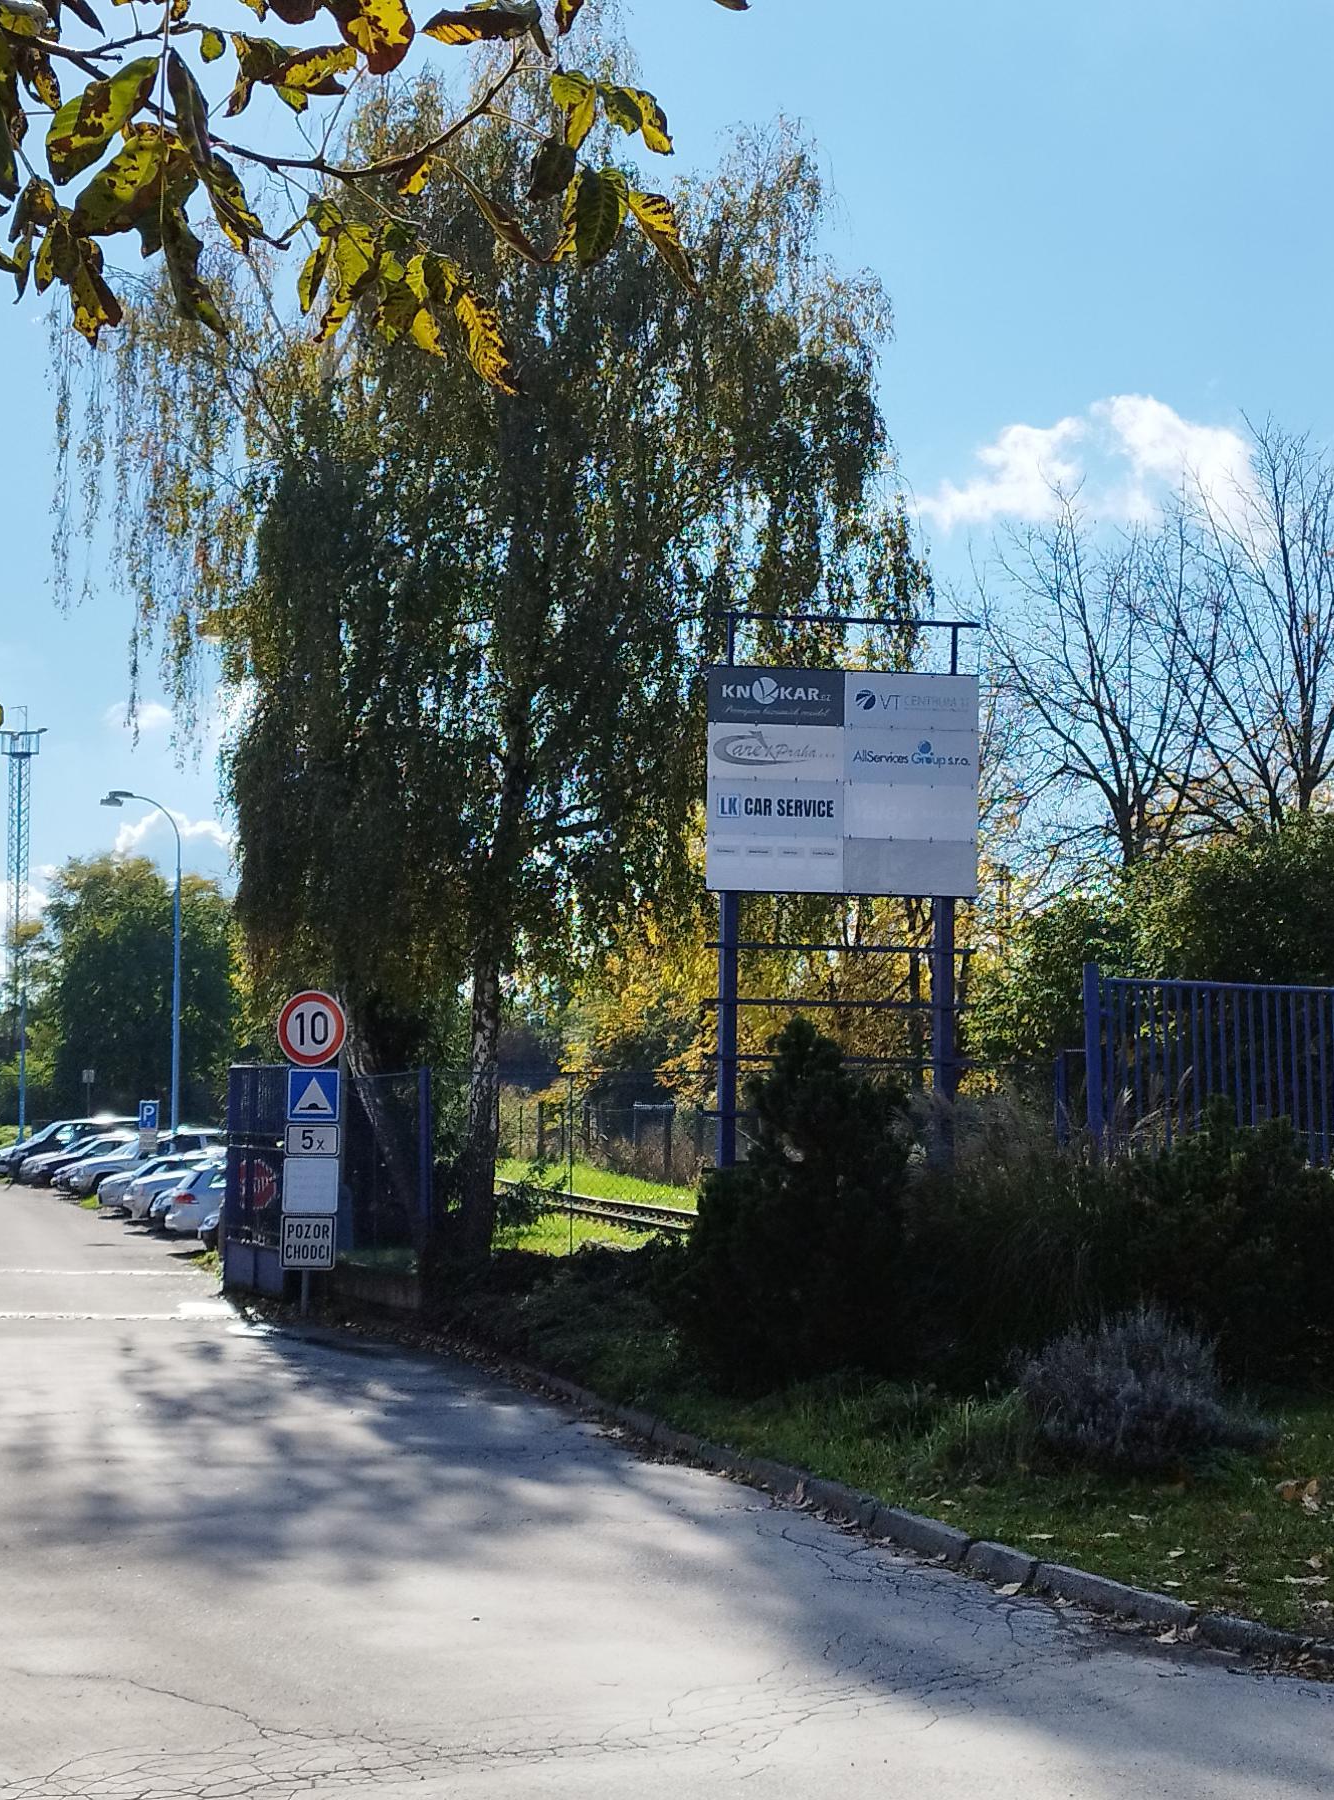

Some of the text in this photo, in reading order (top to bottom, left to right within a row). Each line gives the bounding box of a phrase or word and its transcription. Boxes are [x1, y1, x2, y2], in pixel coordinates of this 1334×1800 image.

[880, 695, 900, 710] VT
[720, 797, 738, 816] LK
[744, 798, 773, 817] CAR
[776, 799, 835, 818] SERVICE
[295, 1011, 329, 1046] 10
[143, 1105, 155, 1122] P
[287, 1223, 330, 1239] POZOR
[285, 1244, 330, 1260] CHODCI
